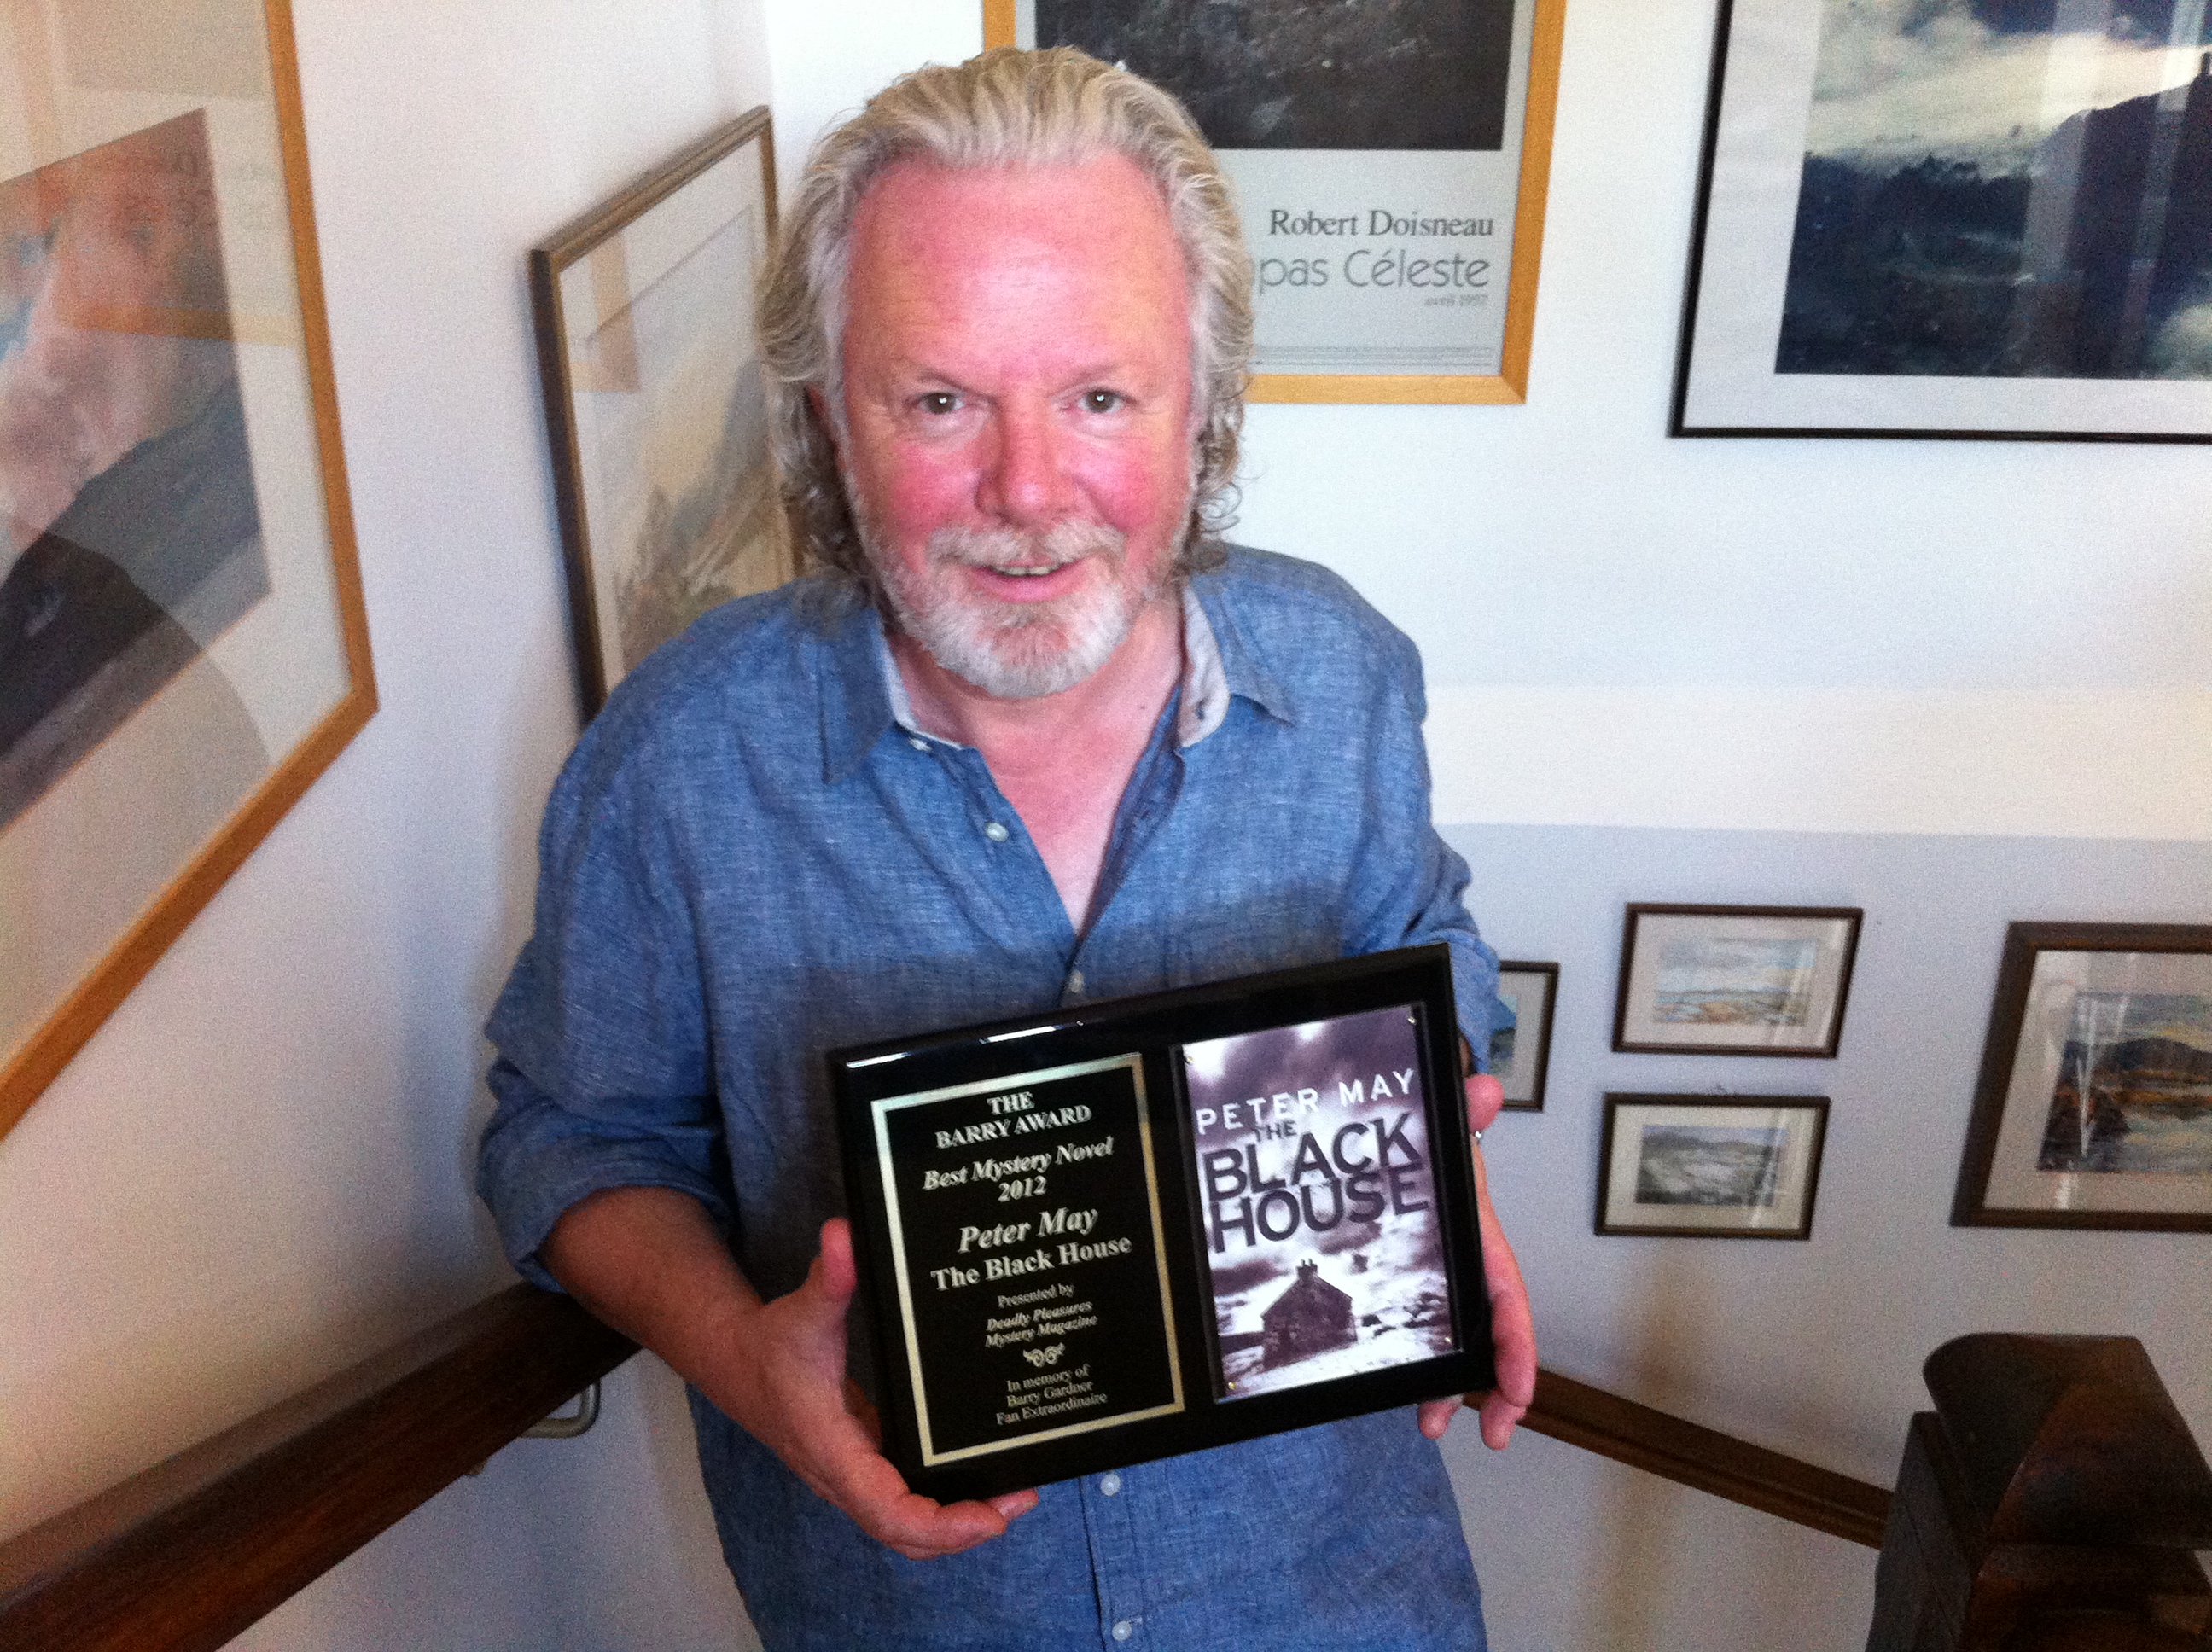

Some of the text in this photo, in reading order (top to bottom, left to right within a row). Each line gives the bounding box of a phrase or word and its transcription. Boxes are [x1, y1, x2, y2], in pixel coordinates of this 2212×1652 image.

[1270, 209, 1493, 236] Robert Doisneau
[1342, 249, 1490, 288] Céleste
[987, 1091, 1035, 1115] THE
[1196, 1067, 1415, 1136] PETER MAY
[934, 1104, 1093, 1149] BARRY AWARD
[1254, 1120, 1298, 1143] THE
[923, 1136, 1115, 1190] Best Mystery Novel
[1202, 1113, 1424, 1201] BLACK
[997, 1175, 1048, 1202] 2012
[1210, 1160, 1429, 1254] HOUSE
[957, 1207, 1099, 1254] Peter May
[930, 1237, 1133, 1291] The Black House
[998, 1283, 1075, 1307] Presented by
[985, 1315, 1098, 1348] Mystery Magazine
[986, 1301, 1093, 1332] Deadly Pleasures
[1007, 1363, 1091, 1393] In memory of
[1007, 1381, 1094, 1407] Barry Gardner
[996, 1393, 1109, 1425] Fan Extraordinaire
